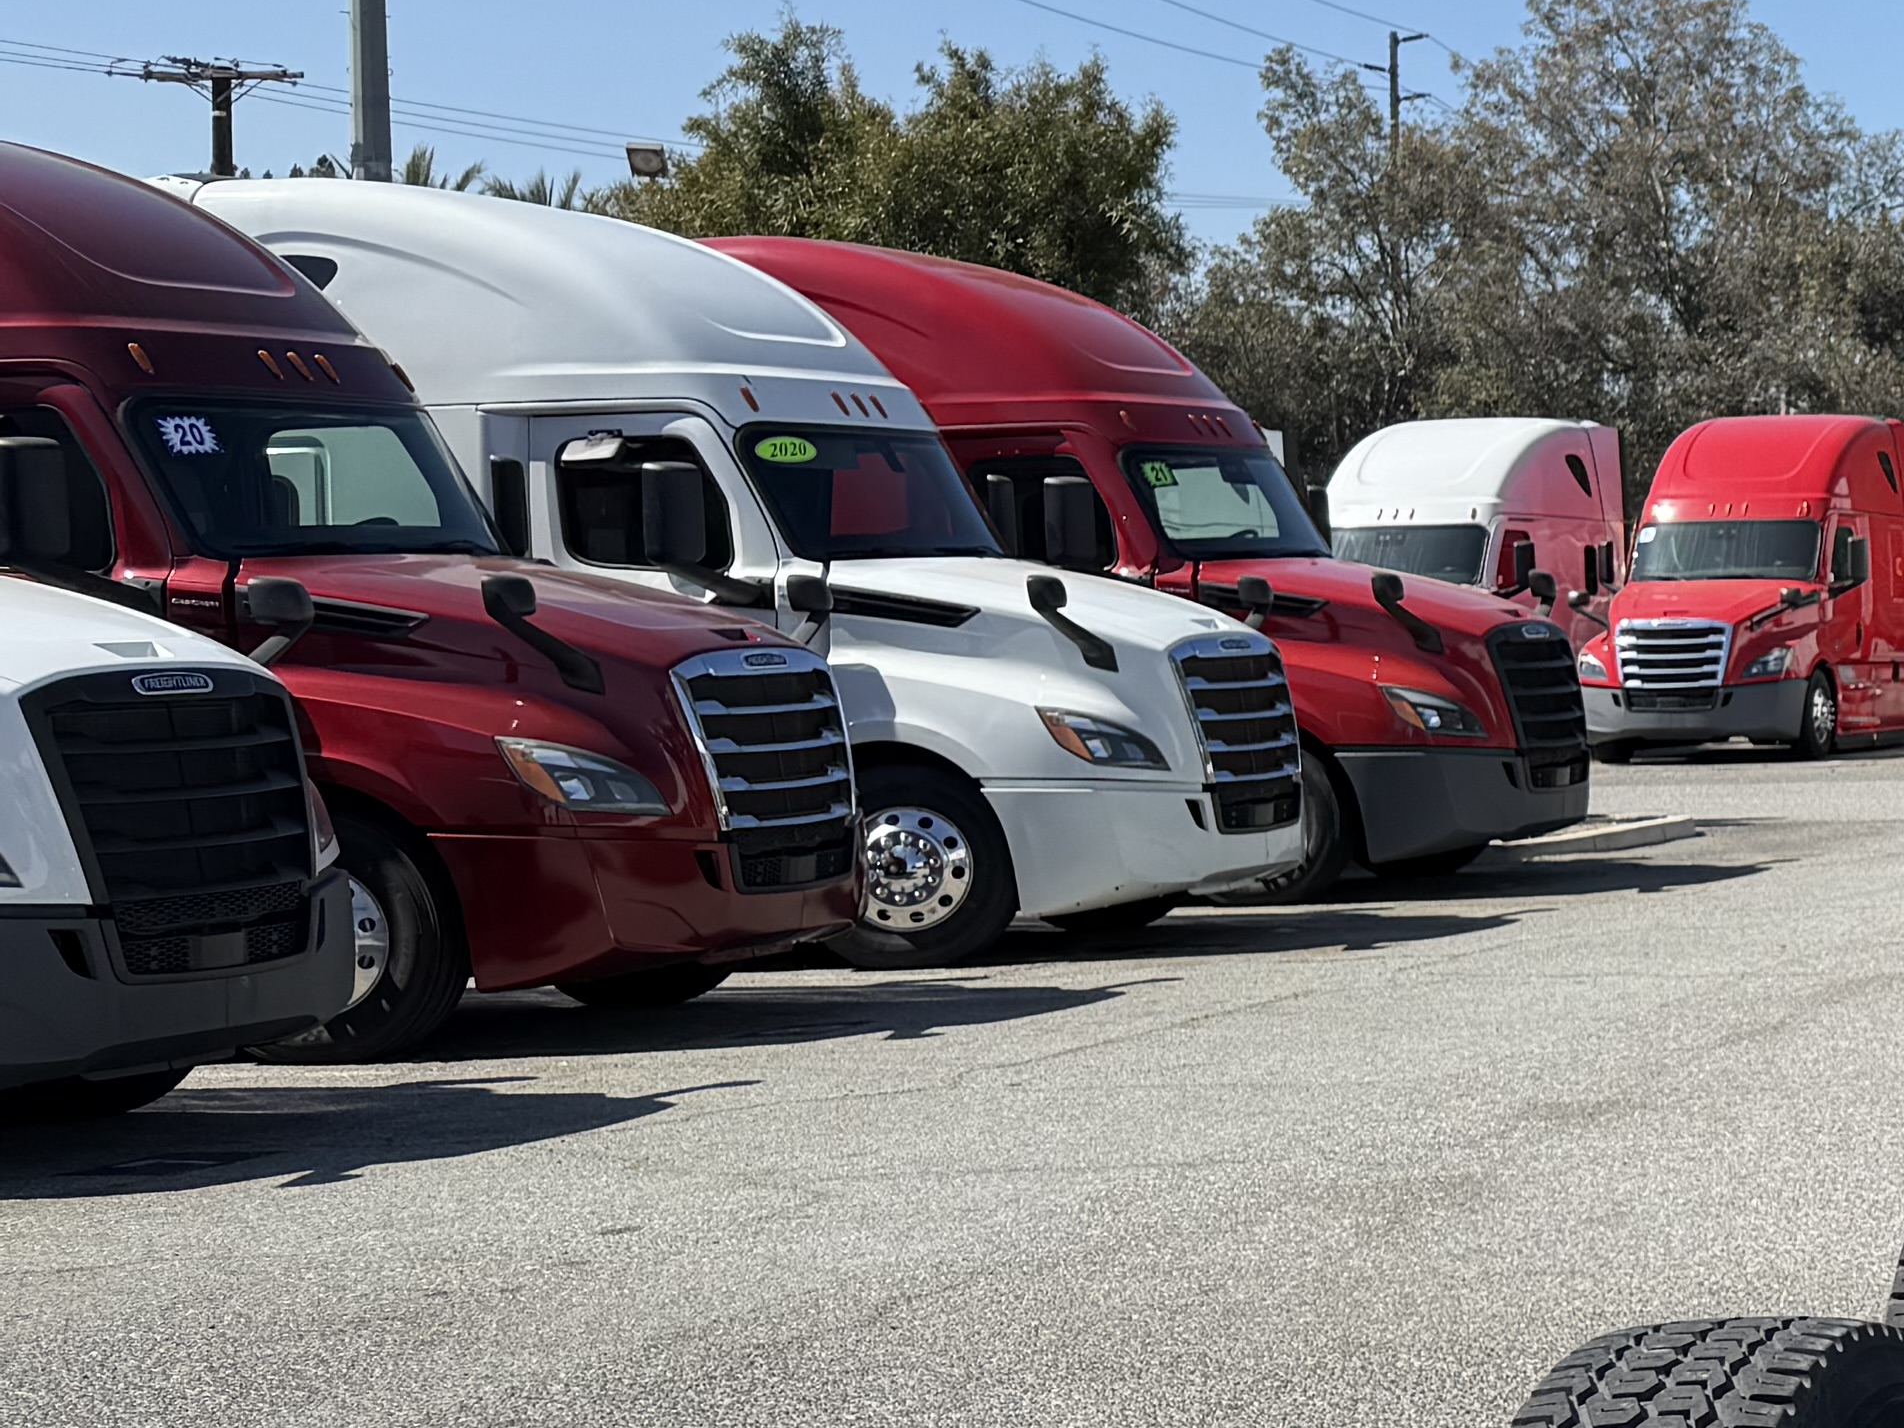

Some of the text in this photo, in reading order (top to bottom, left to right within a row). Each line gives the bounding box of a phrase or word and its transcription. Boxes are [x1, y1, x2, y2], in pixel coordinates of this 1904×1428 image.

[173, 422, 205, 447] 20
[769, 441, 807, 458] 2020
[1150, 465, 1168, 482] 21
